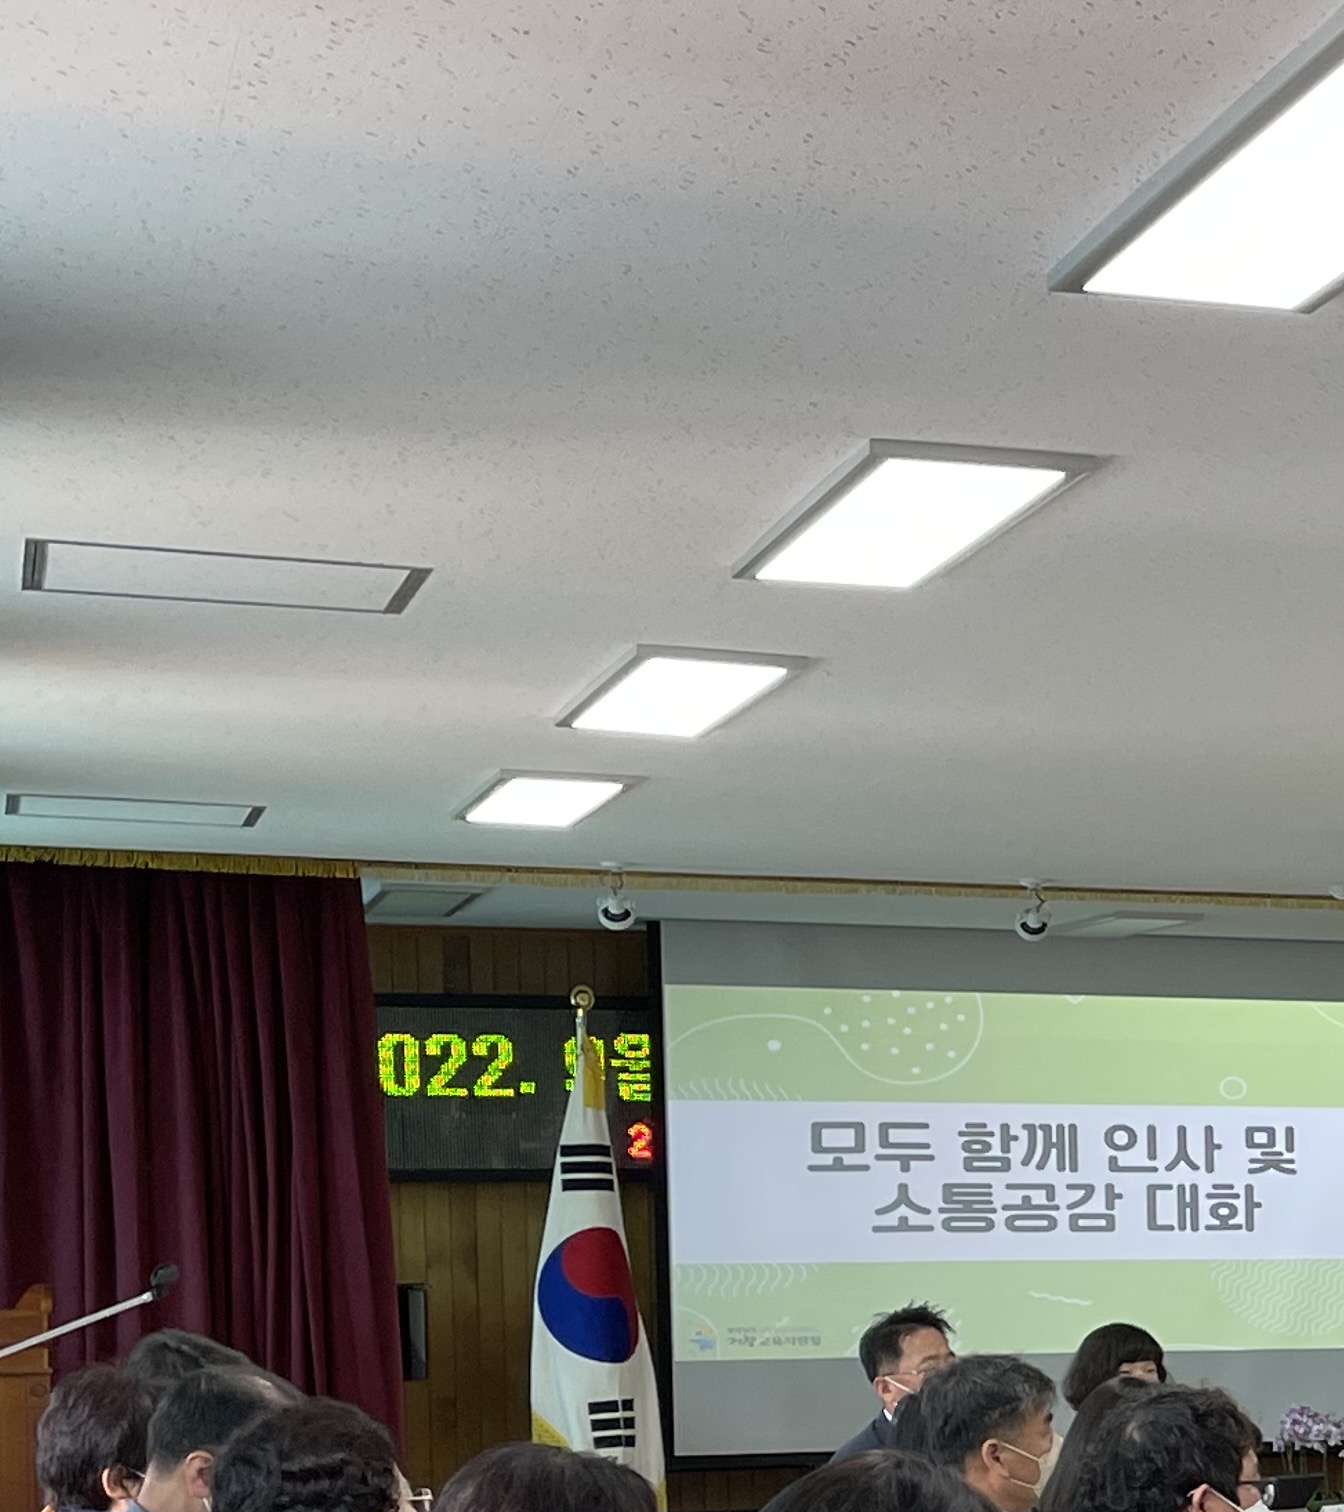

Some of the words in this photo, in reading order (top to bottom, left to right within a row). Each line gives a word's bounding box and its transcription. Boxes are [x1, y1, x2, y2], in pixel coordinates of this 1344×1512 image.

[806, 1119, 936, 1173] 모두
[957, 1121, 1079, 1175] 함께
[1103, 1123, 1223, 1176] 인사
[1245, 1124, 1298, 1176] 및
[870, 1183, 1123, 1233] 소통공감
[1145, 1182, 1262, 1233] 대화
